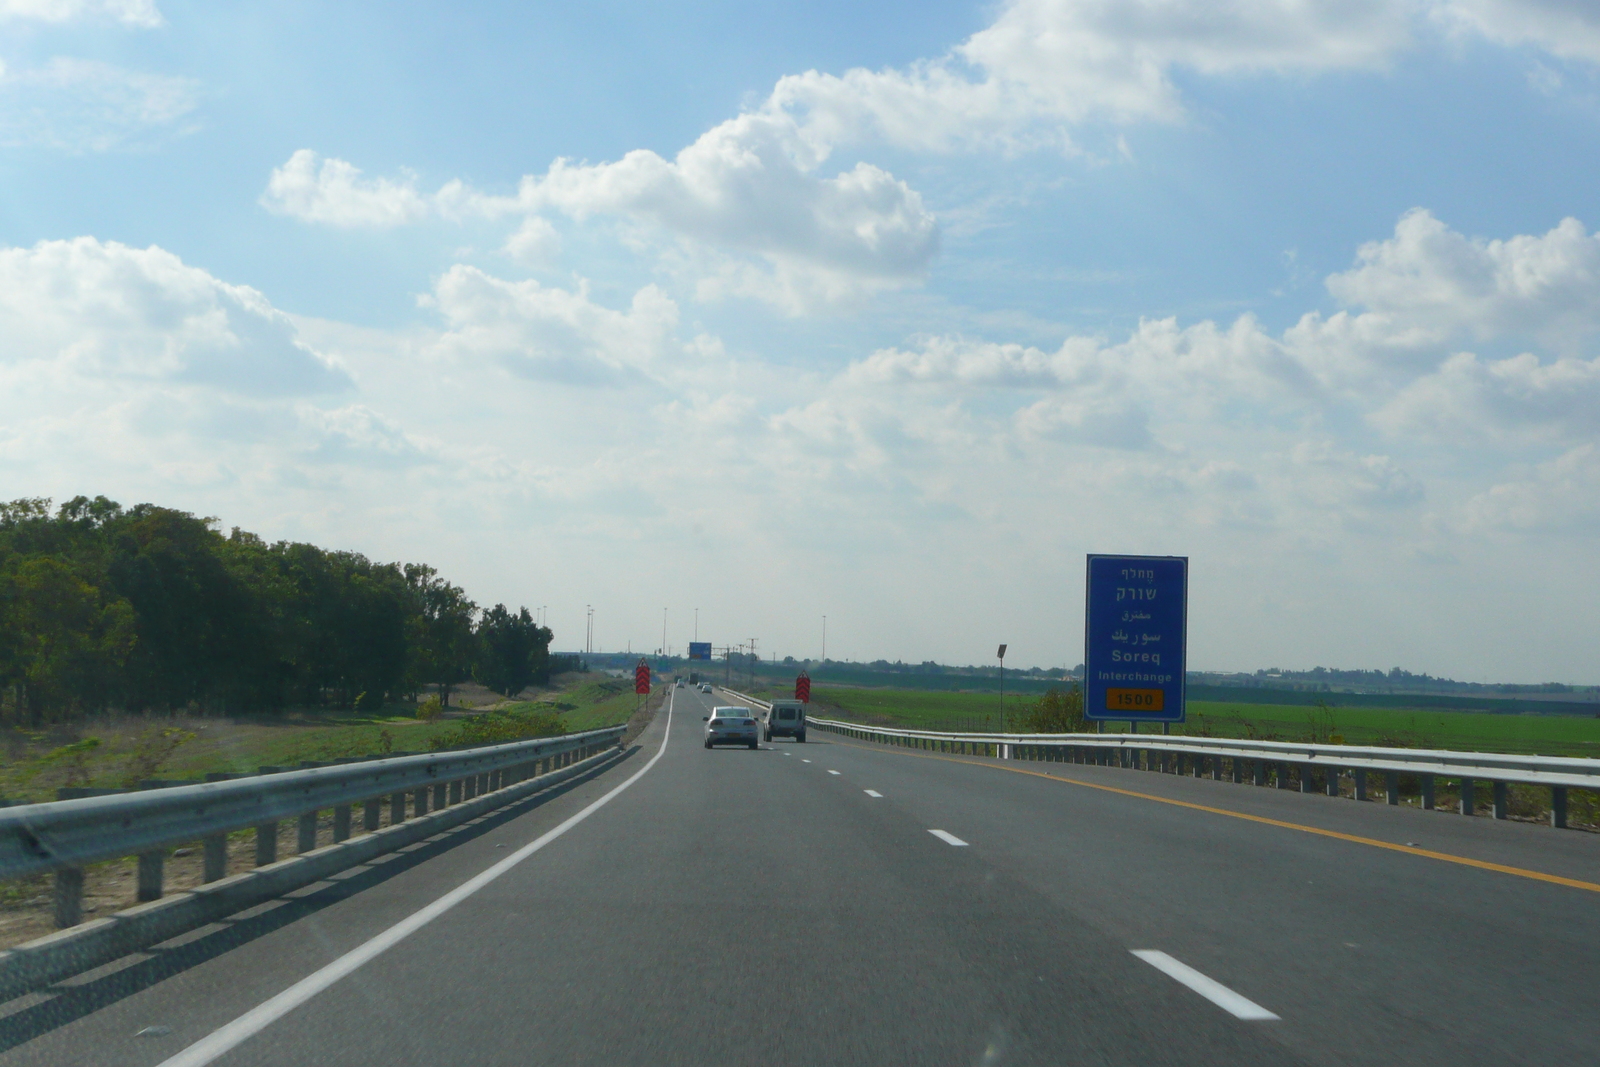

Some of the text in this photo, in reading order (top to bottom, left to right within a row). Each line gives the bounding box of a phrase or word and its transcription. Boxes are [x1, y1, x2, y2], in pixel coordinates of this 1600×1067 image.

[1116, 587, 1157, 601] שורק
[1121, 610, 1151, 622] مفترق
[1111, 649, 1161, 666] Soreq
[1098, 671, 1172, 684] Interchange
[1117, 694, 1153, 705] 1500
